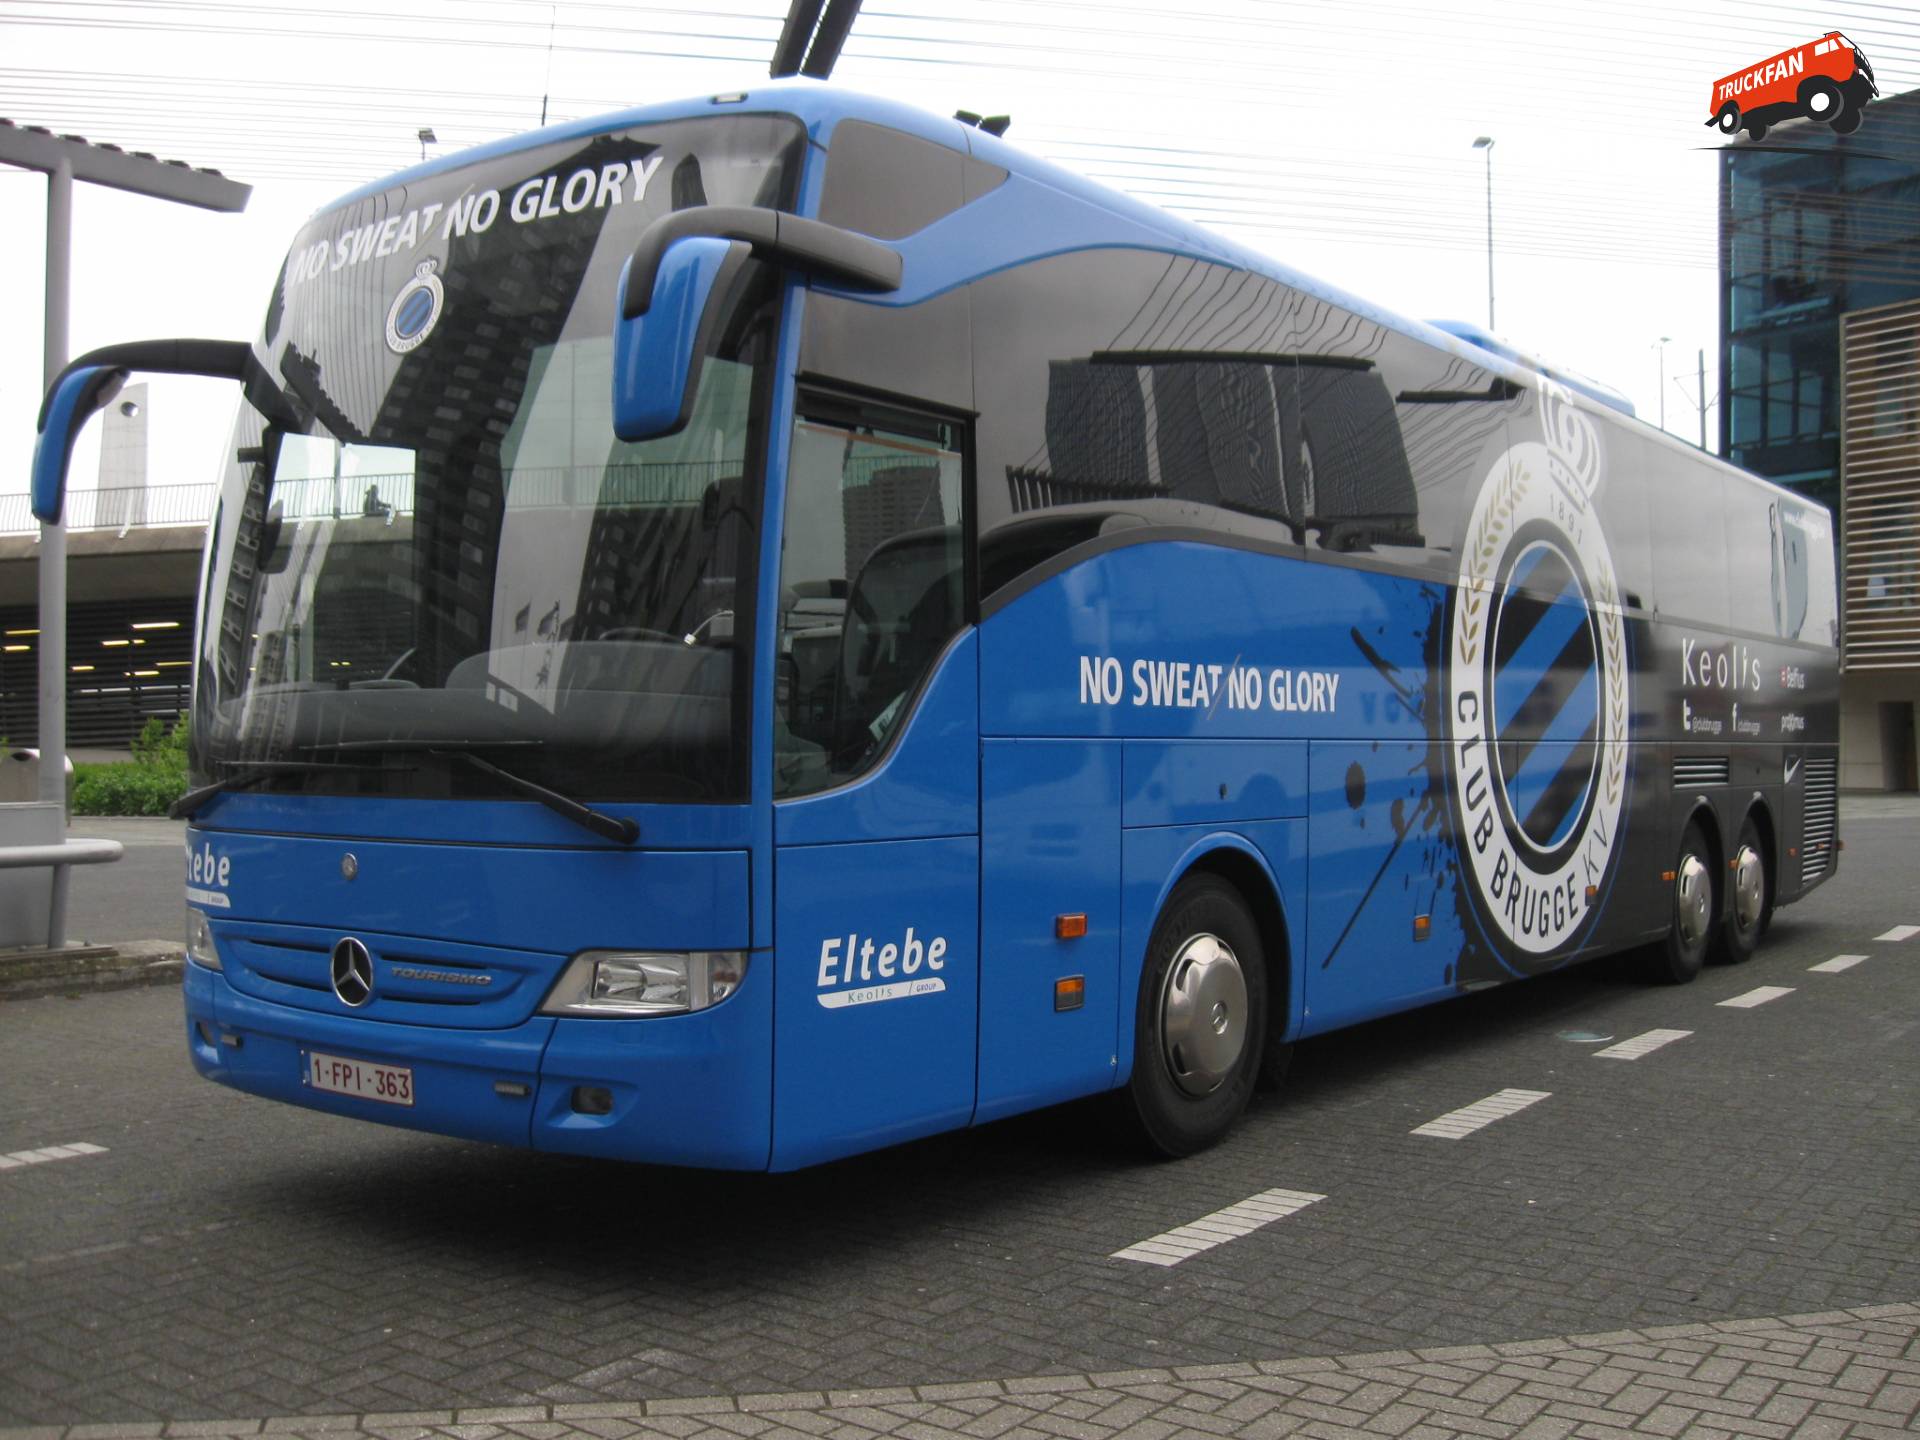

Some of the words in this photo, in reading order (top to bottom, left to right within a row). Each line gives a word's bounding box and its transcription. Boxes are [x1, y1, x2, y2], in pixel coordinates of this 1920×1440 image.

[289, 240, 330, 288] NO
[331, 203, 443, 272] SWEAT
[442, 190, 500, 240] NO
[510, 157, 664, 223] GLORY
[1550, 493, 1583, 545] 1891
[1080, 656, 1124, 705] NO
[1132, 659, 1223, 708] SWEAT
[1228, 666, 1262, 710] NO
[1269, 669, 1340, 713] GLORY
[1682, 637, 1761, 691] Keolis
[1458, 690, 1494, 854] CLUB
[1490, 848, 1579, 938] BRUGGE
[391, 967, 492, 986] TOURISMO
[817, 927, 947, 987] Eltebe
[847, 987, 893, 1004] Keolis
